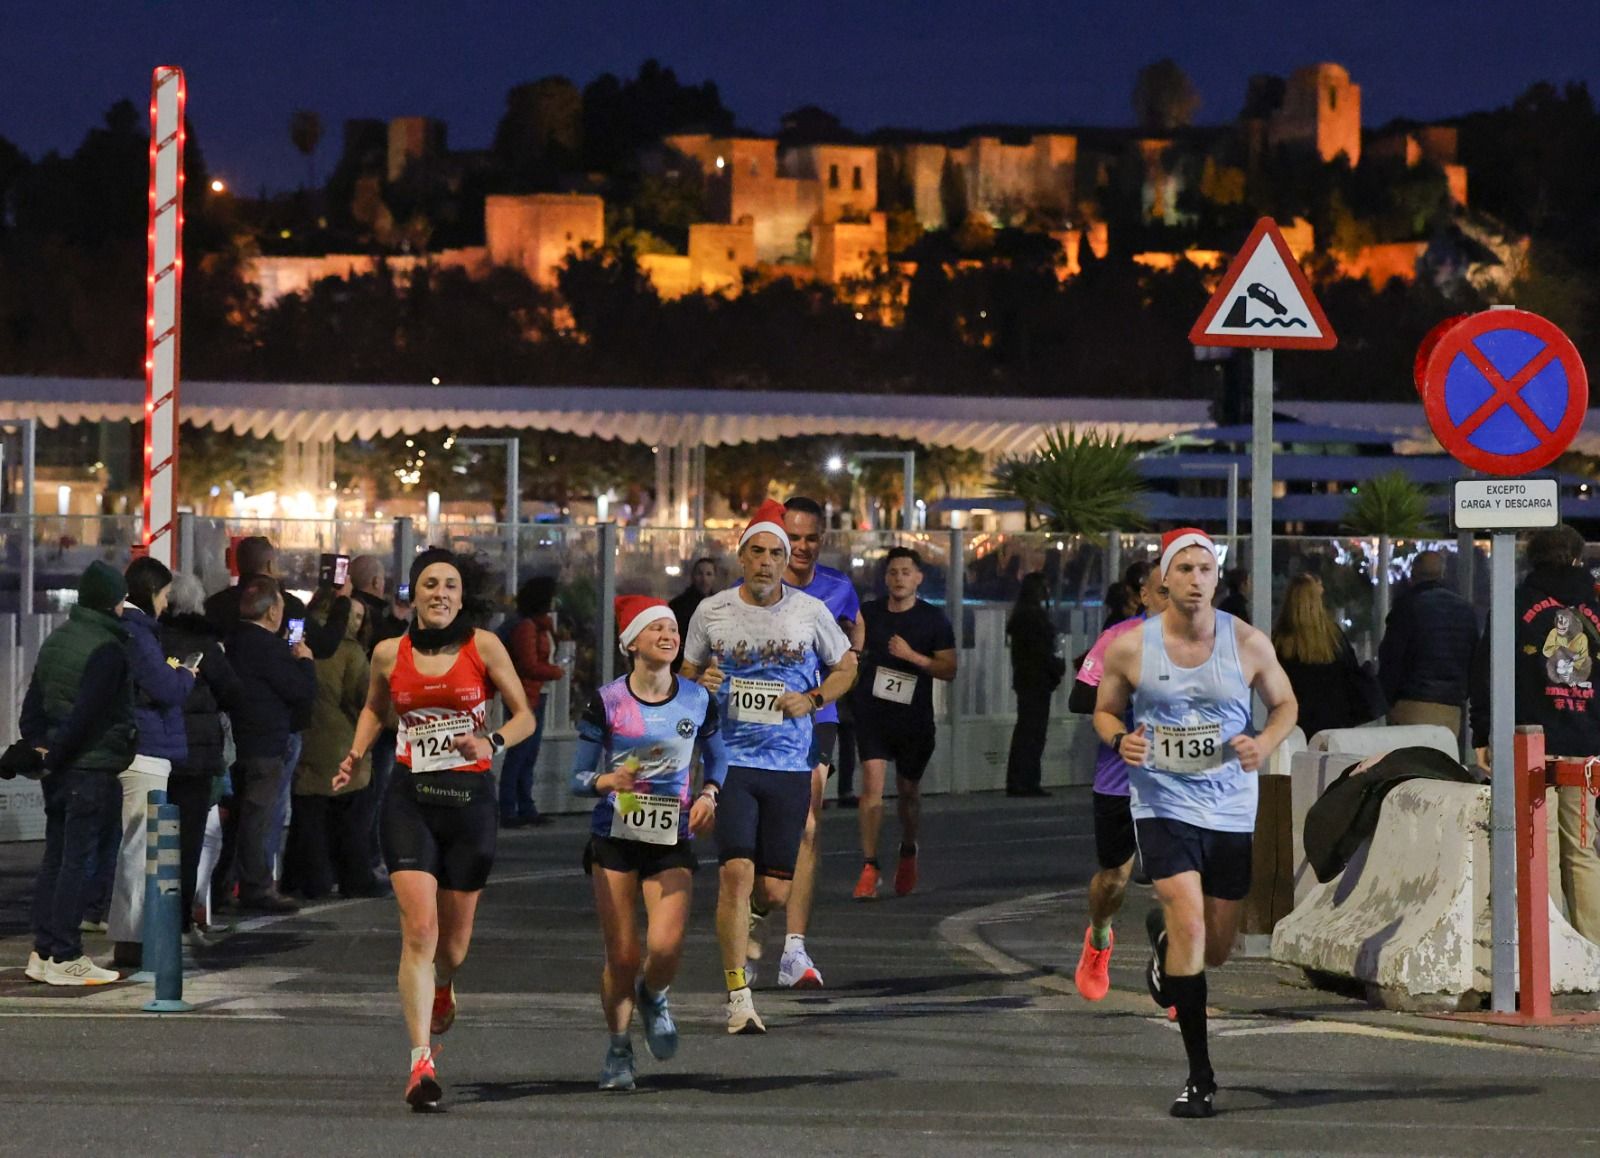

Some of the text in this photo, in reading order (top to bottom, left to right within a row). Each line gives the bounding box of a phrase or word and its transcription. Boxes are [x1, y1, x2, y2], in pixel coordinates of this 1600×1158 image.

[1486, 485, 1526, 495] EXCEPTO
[1461, 498, 1552, 509] CARGA Y DESCARGA
[885, 678, 902, 693] 21
[733, 691, 778, 711] 1097
[417, 732, 466, 757] 124
[1161, 738, 1215, 758] 1138
